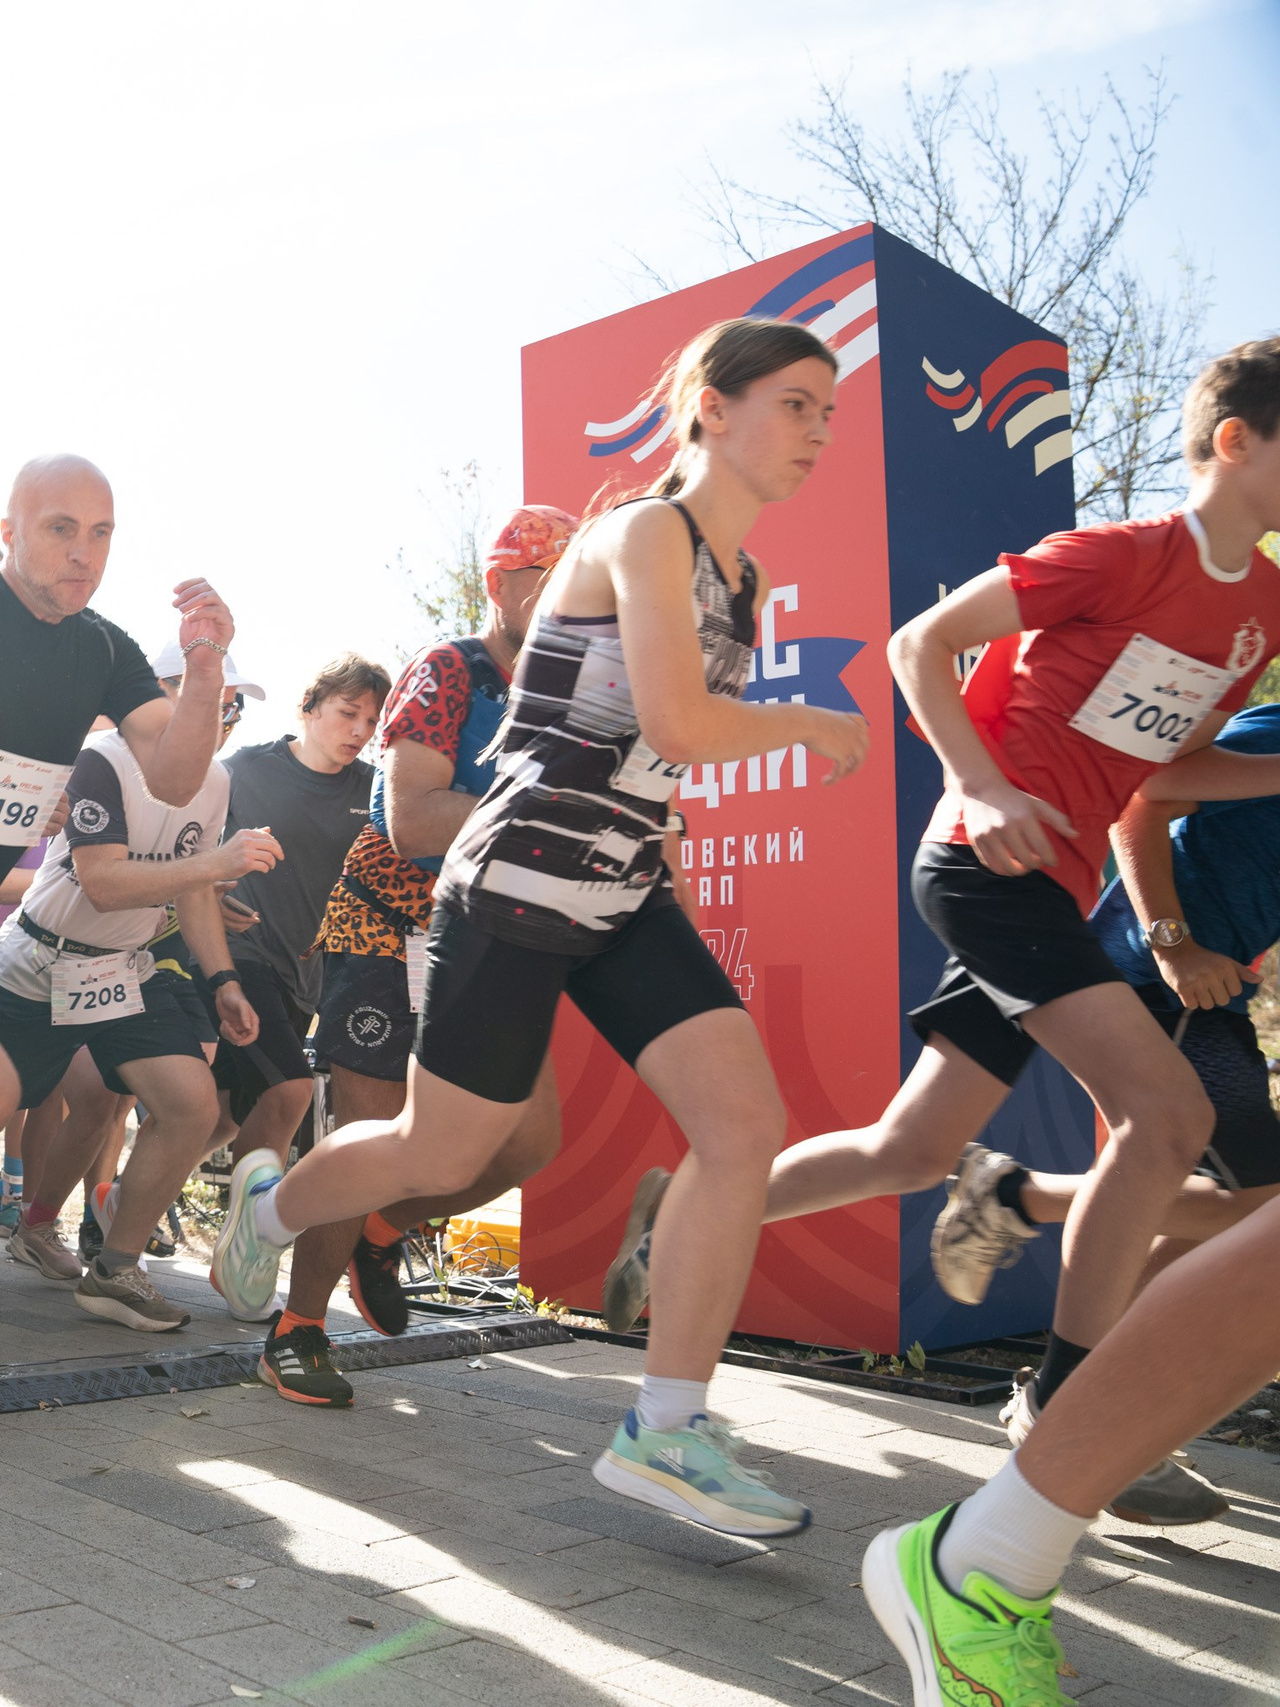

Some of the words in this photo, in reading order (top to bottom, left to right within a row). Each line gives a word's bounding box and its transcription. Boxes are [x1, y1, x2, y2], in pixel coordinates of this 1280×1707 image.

[1108, 693, 1194, 743] 7002
[681, 826, 804, 870] ОВСКИЙ
[686, 874, 734, 907] АП
[68, 984, 126, 1010] 7208
